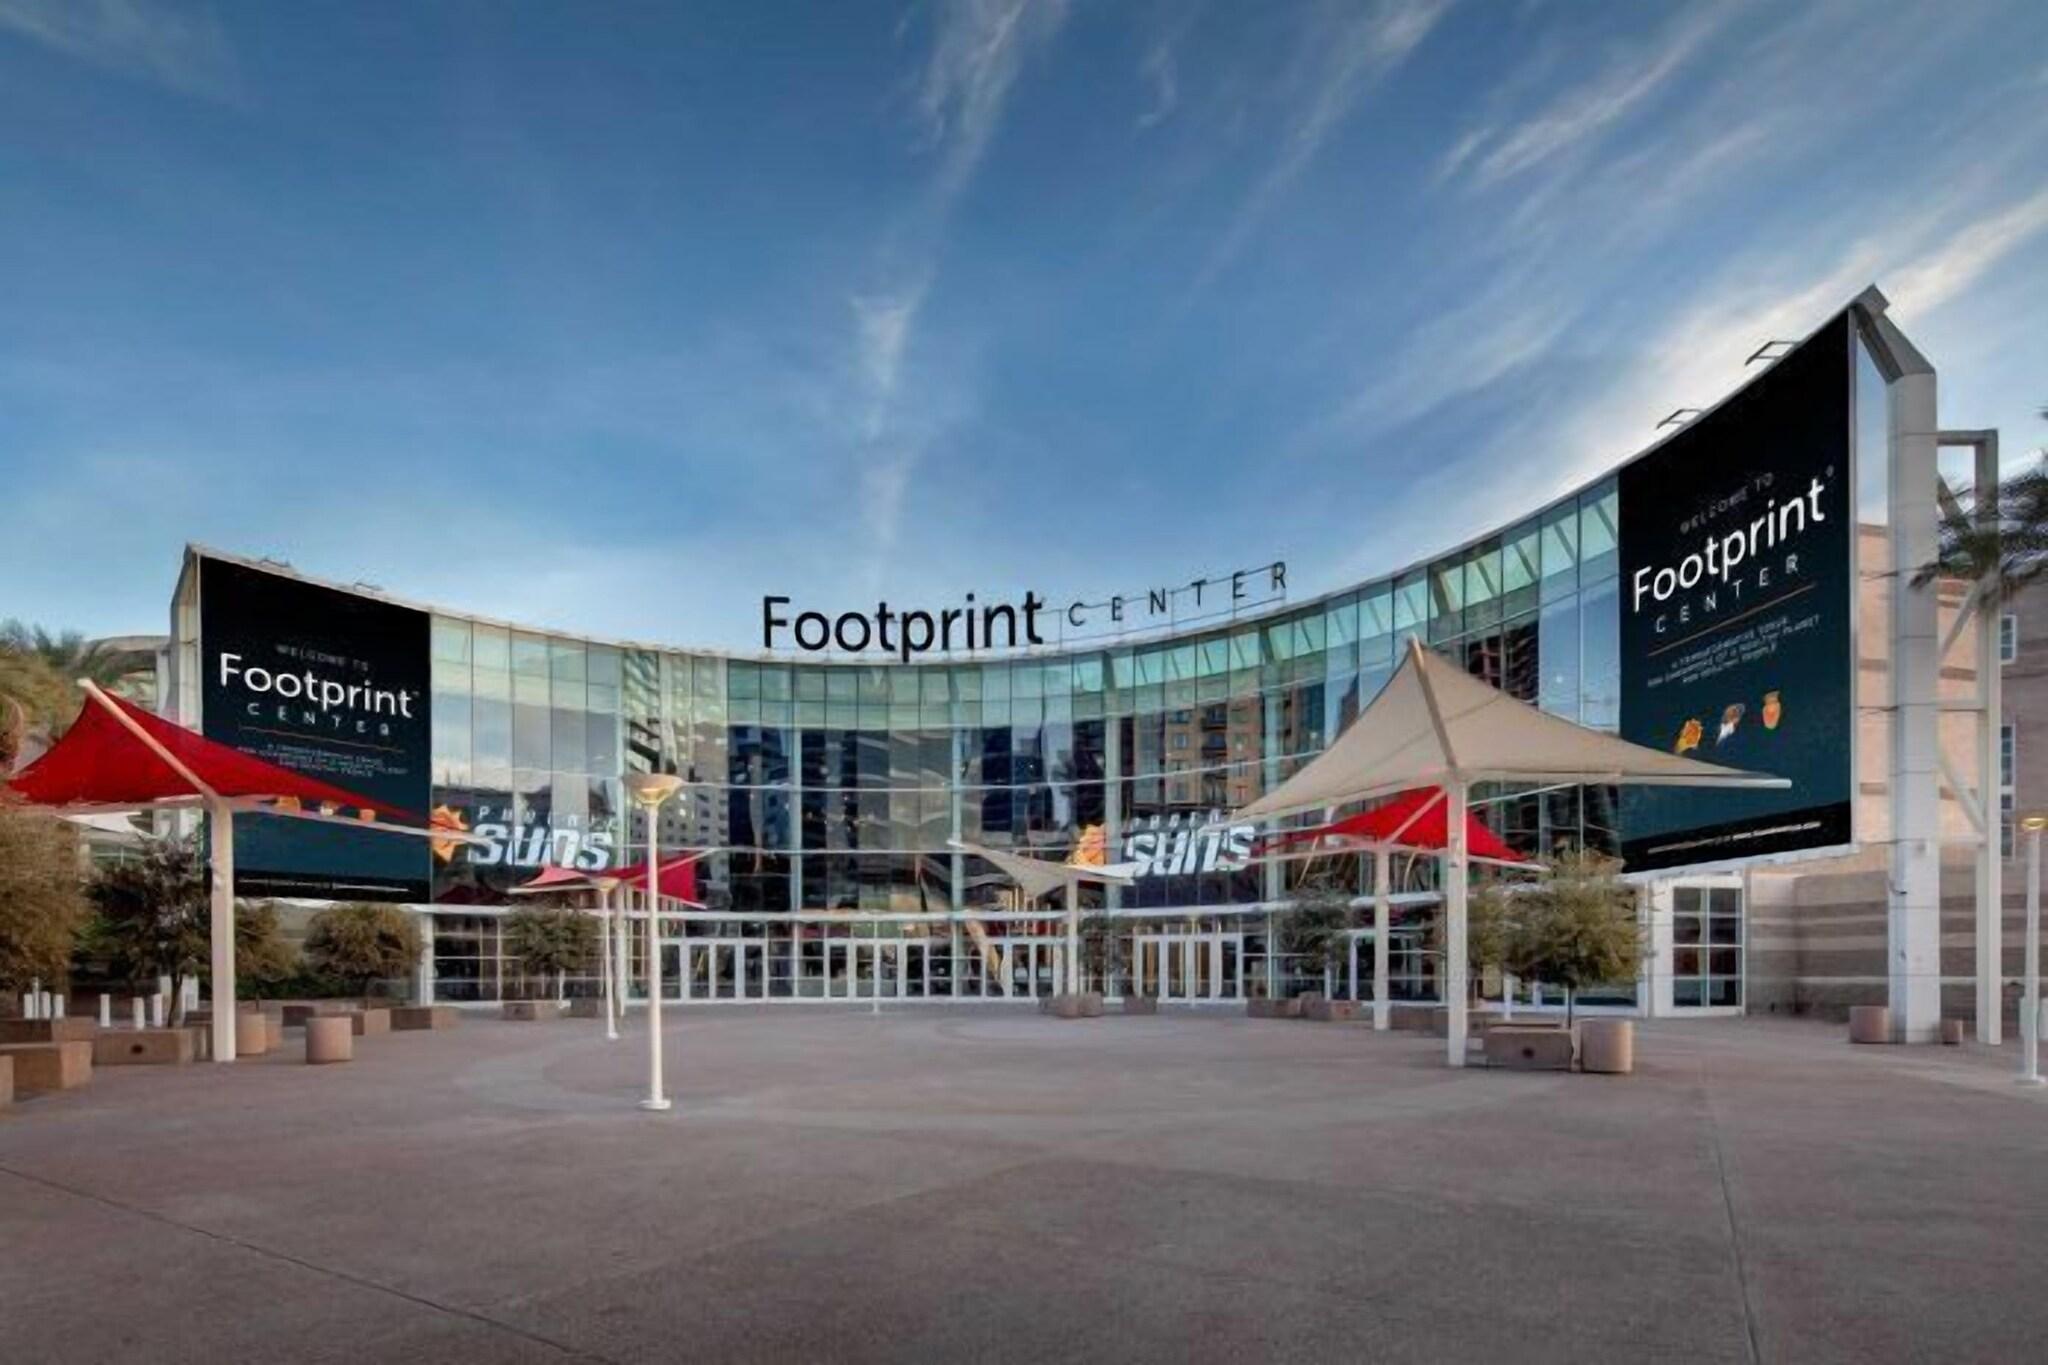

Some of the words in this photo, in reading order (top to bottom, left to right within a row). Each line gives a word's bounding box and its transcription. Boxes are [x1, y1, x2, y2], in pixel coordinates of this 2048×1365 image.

[1632, 478, 1826, 613] Footprint
[763, 590, 1043, 662] Footprint
[1067, 561, 1287, 627] CENTER
[1654, 553, 1800, 635] CENTER
[219, 652, 414, 718] Footprint
[246, 702, 390, 736] CENTER
